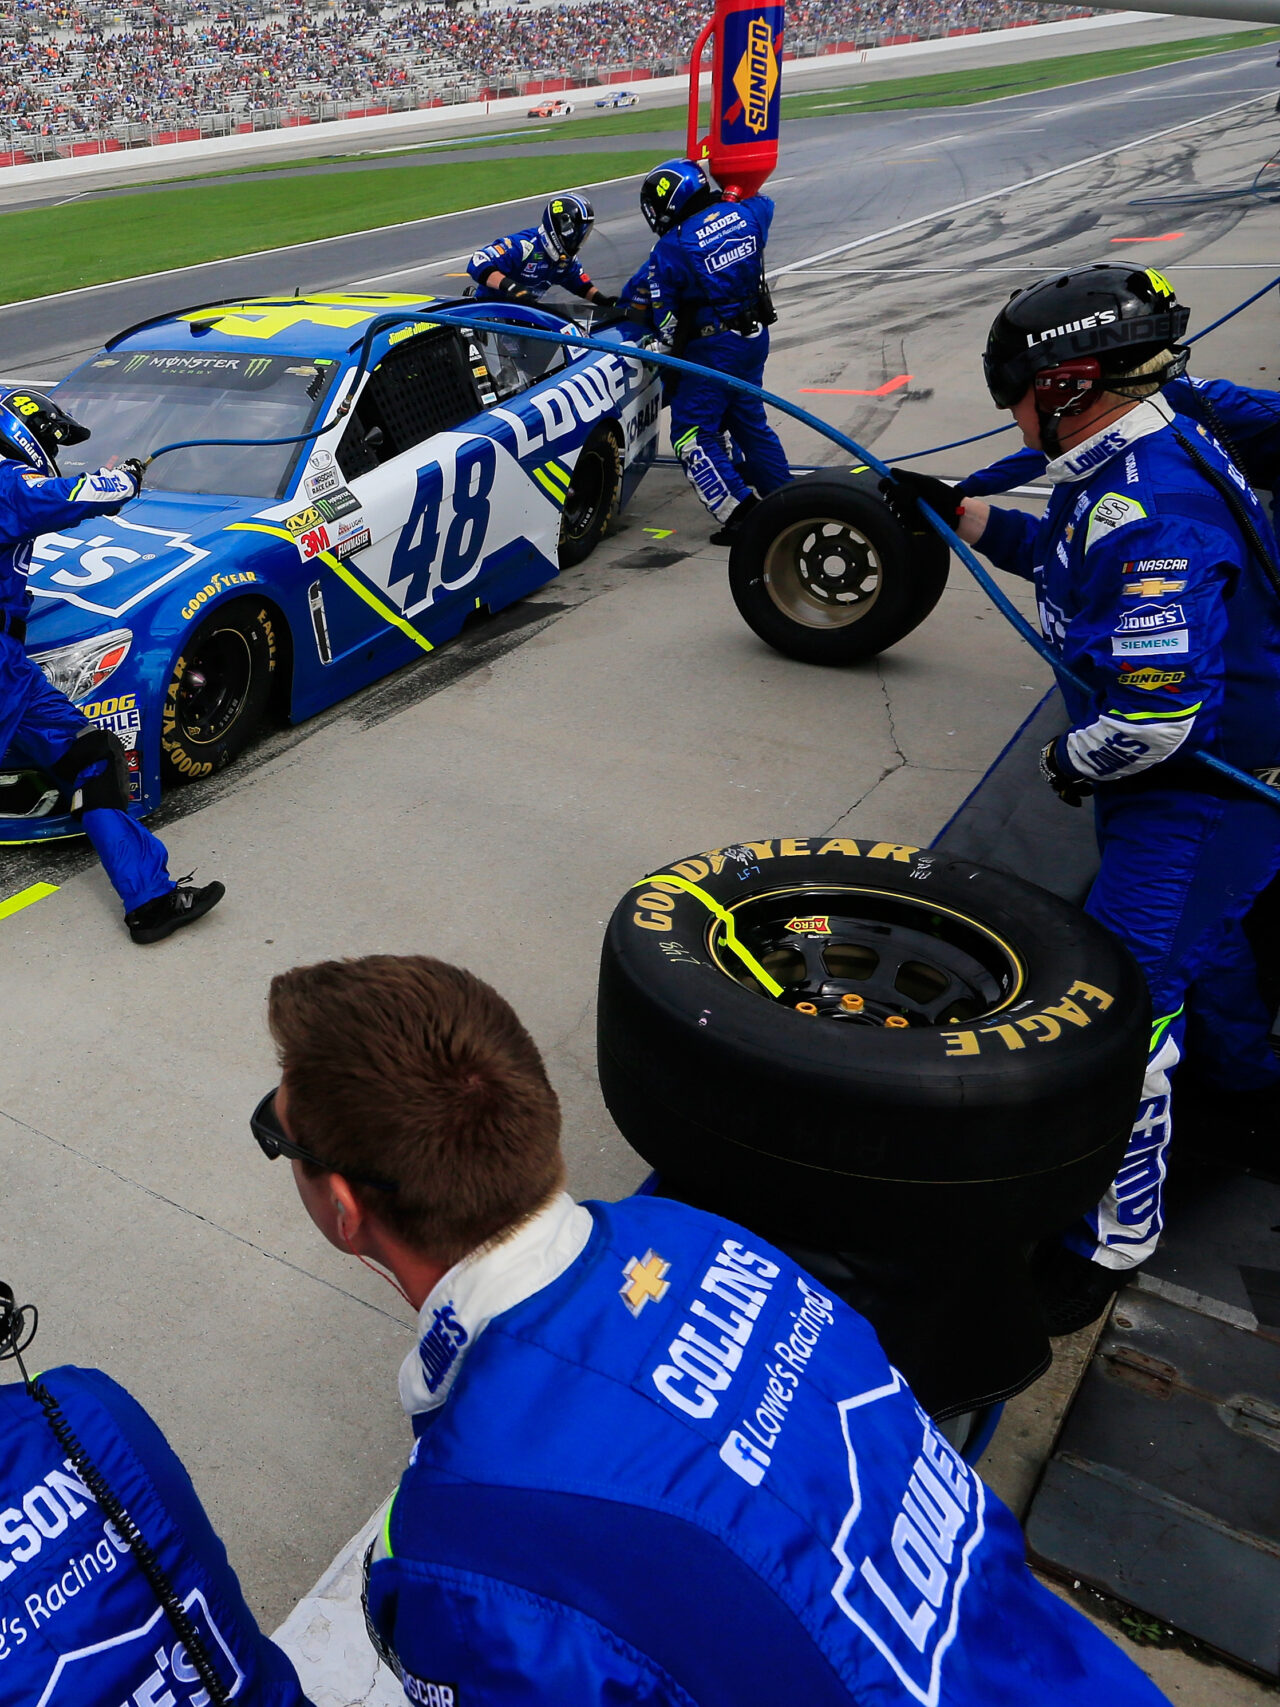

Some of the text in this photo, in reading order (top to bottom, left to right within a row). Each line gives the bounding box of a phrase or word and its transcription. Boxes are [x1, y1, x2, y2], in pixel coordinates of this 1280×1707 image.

[749, 25, 770, 129] SUNOCO
[656, 177, 671, 198] 48
[551, 200, 564, 214] 48
[695, 211, 741, 240] HARDER
[710, 241, 753, 270] LOWE'S
[1026, 309, 1116, 348] LOWE'S
[148, 356, 241, 371] MONSTER
[161, 368, 213, 376] ENERGY
[11, 395, 40, 417] 48
[488, 340, 645, 459] LOWES
[626, 393, 660, 441] OBALT
[12, 430, 44, 468] LOWE'S
[1063, 430, 1129, 476] LOWE'S
[1124, 451, 1139, 485] KOBALT
[311, 479, 336, 495] RACE CAR
[688, 448, 731, 512] LOWE'S
[301, 525, 331, 558] 3M
[387, 437, 497, 612] 48
[1137, 558, 1188, 572] NASCAR
[181, 571, 257, 621] GOODYEAR
[1123, 610, 1177, 630] LOWE'S
[257, 608, 277, 673] EAGLE
[1120, 637, 1179, 650] SIEMENS
[1119, 671, 1185, 685] SUNOCO
[78, 693, 136, 720] OOG
[162, 656, 213, 777] GOODYEAR
[633, 837, 920, 932] GOODYEAR
[793, 920, 824, 930] AERO
[939, 979, 1115, 1057] EAGLE
[651, 1239, 781, 1419] COLLINS
[743, 1365, 799, 1450] Lowe's
[773, 1287, 836, 1374] Racing
[859, 1406, 971, 1654] LOWE'S
[24, 1538, 119, 1629] Racing
